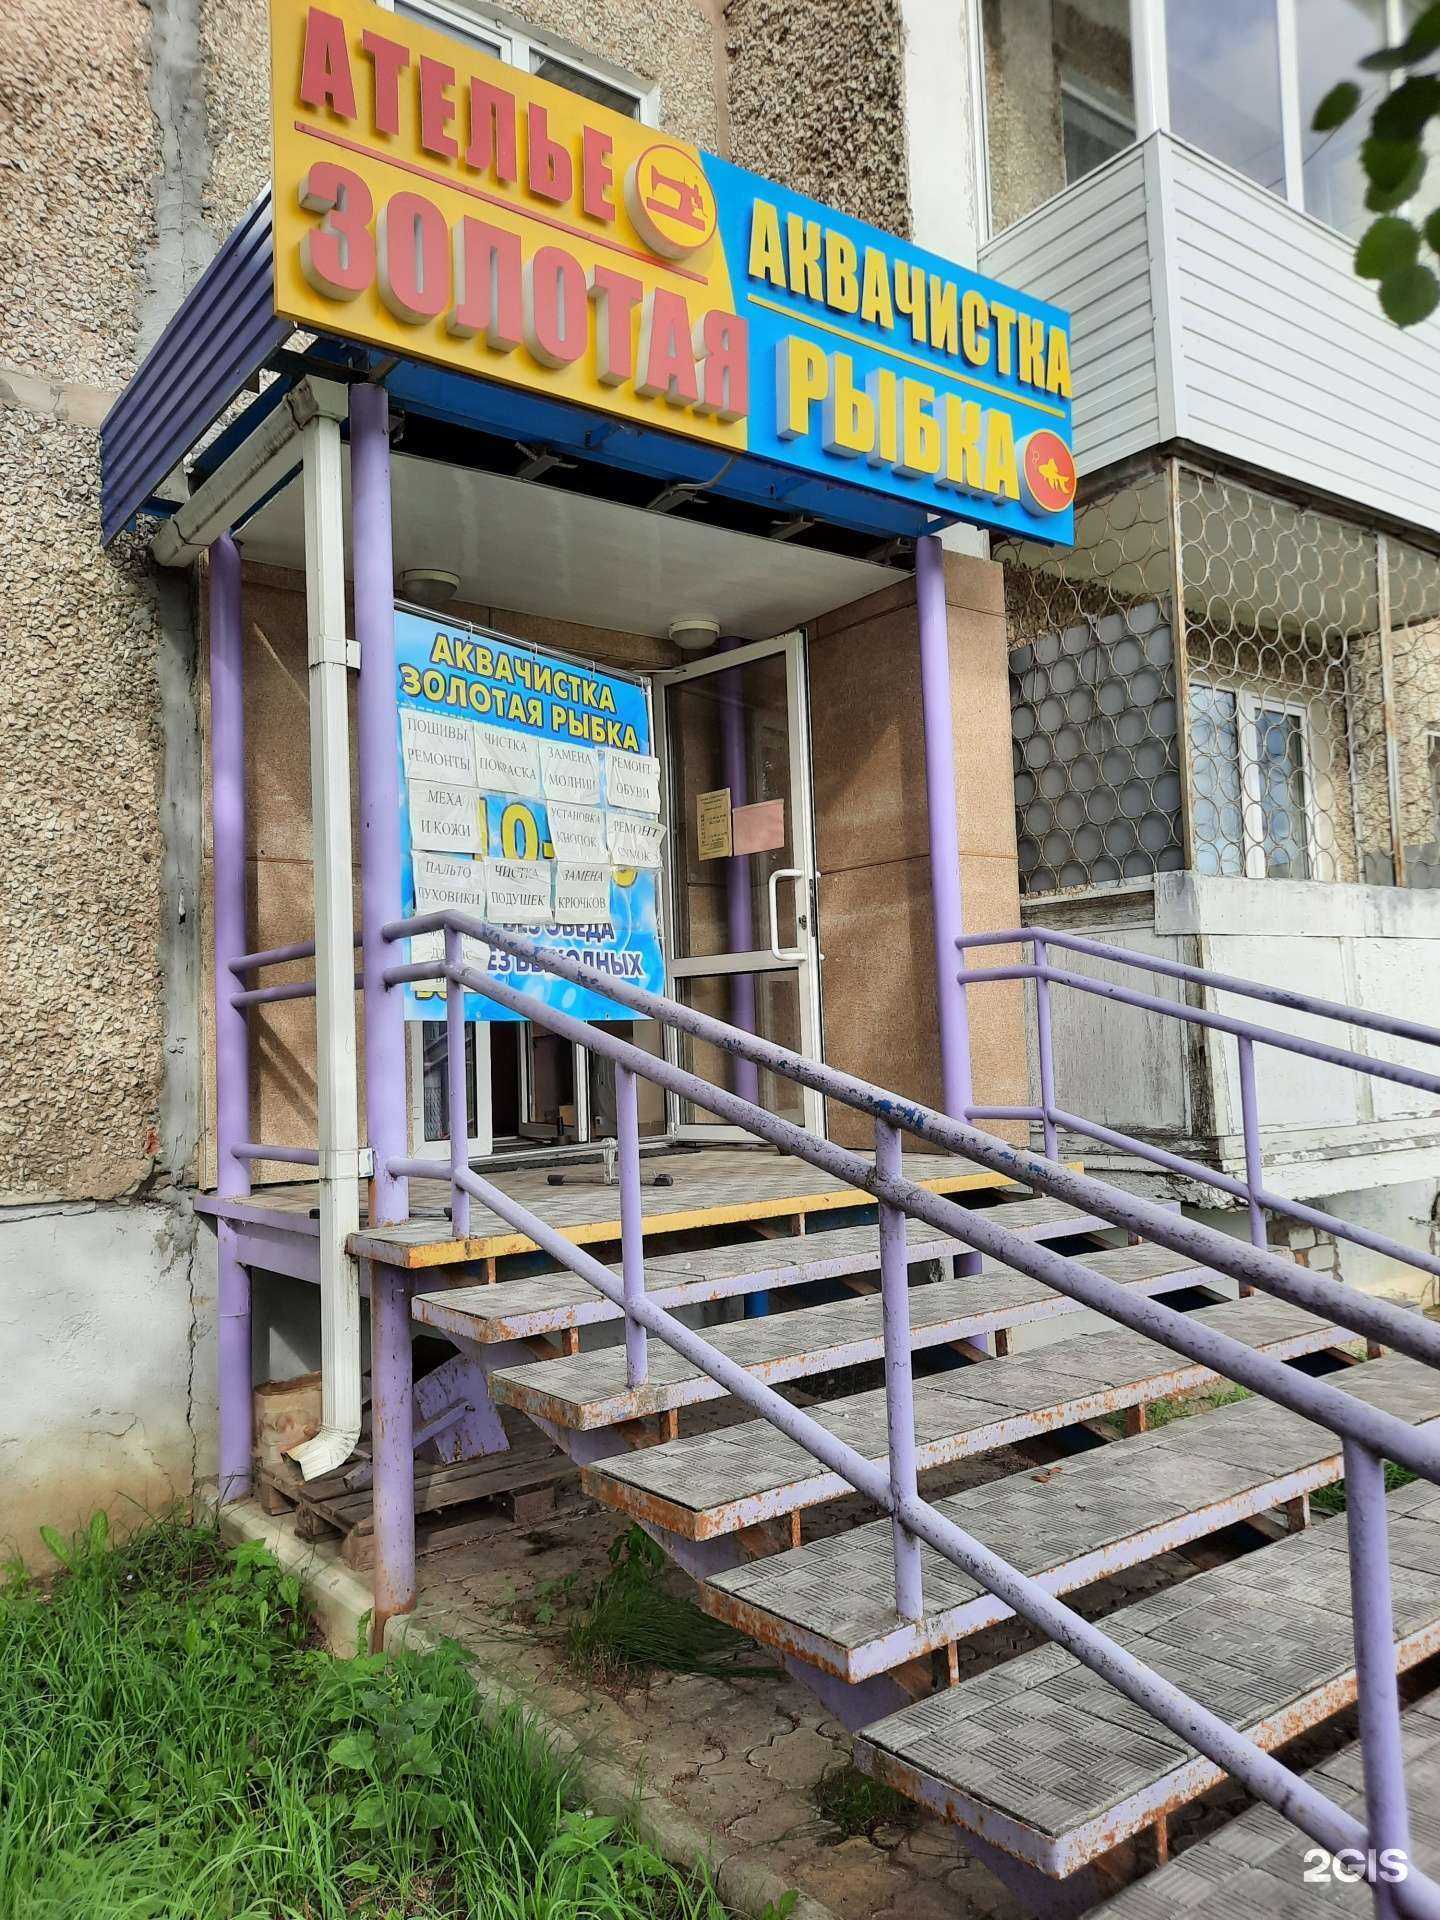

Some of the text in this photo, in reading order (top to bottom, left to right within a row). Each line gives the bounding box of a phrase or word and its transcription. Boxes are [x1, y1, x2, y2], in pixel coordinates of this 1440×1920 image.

[300, 6, 616, 223] АТЕЛЬЕ
[301, 161, 748, 422] ЗОЛОТАЯ
[748, 198, 1072, 399] АКВАЧИСТКА
[778, 335, 1021, 502] РЫБКА
[430, 632, 617, 713] АКВАЧИСТКА
[399, 664, 640, 752] ЗОЛОТАЯ РЫБКА
[407, 717, 467, 741] ПОШИВЫ
[484, 732, 528, 753] ЧИСТКА
[407, 747, 470, 771] РЕМОНТЫ
[548, 747, 592, 766] ЗАМЕНА
[611, 755, 651, 775] РЕМОНТ
[480, 757, 537, 780] ПОКРАСКА
[427, 789, 463, 807] МЕХА
[616, 782, 650, 799] ОБУВИ
[552, 807, 600, 824] УСТАНОВКА
[421, 819, 471, 837] И КОЖИ
[614, 820, 661, 838] РЕМОНТ
[556, 831, 597, 848] КНОПОК
[425, 861, 472, 878] ПАЛЬТО
[564, 869, 603, 882] ЗАМЕНА
[418, 886, 480, 905] ПУХОВИКИ
[491, 891, 546, 906] ПОДУШЕК
[558, 897, 606, 909] КРЮЧКОВ
[487, 949, 511, 971] ЕЗ
